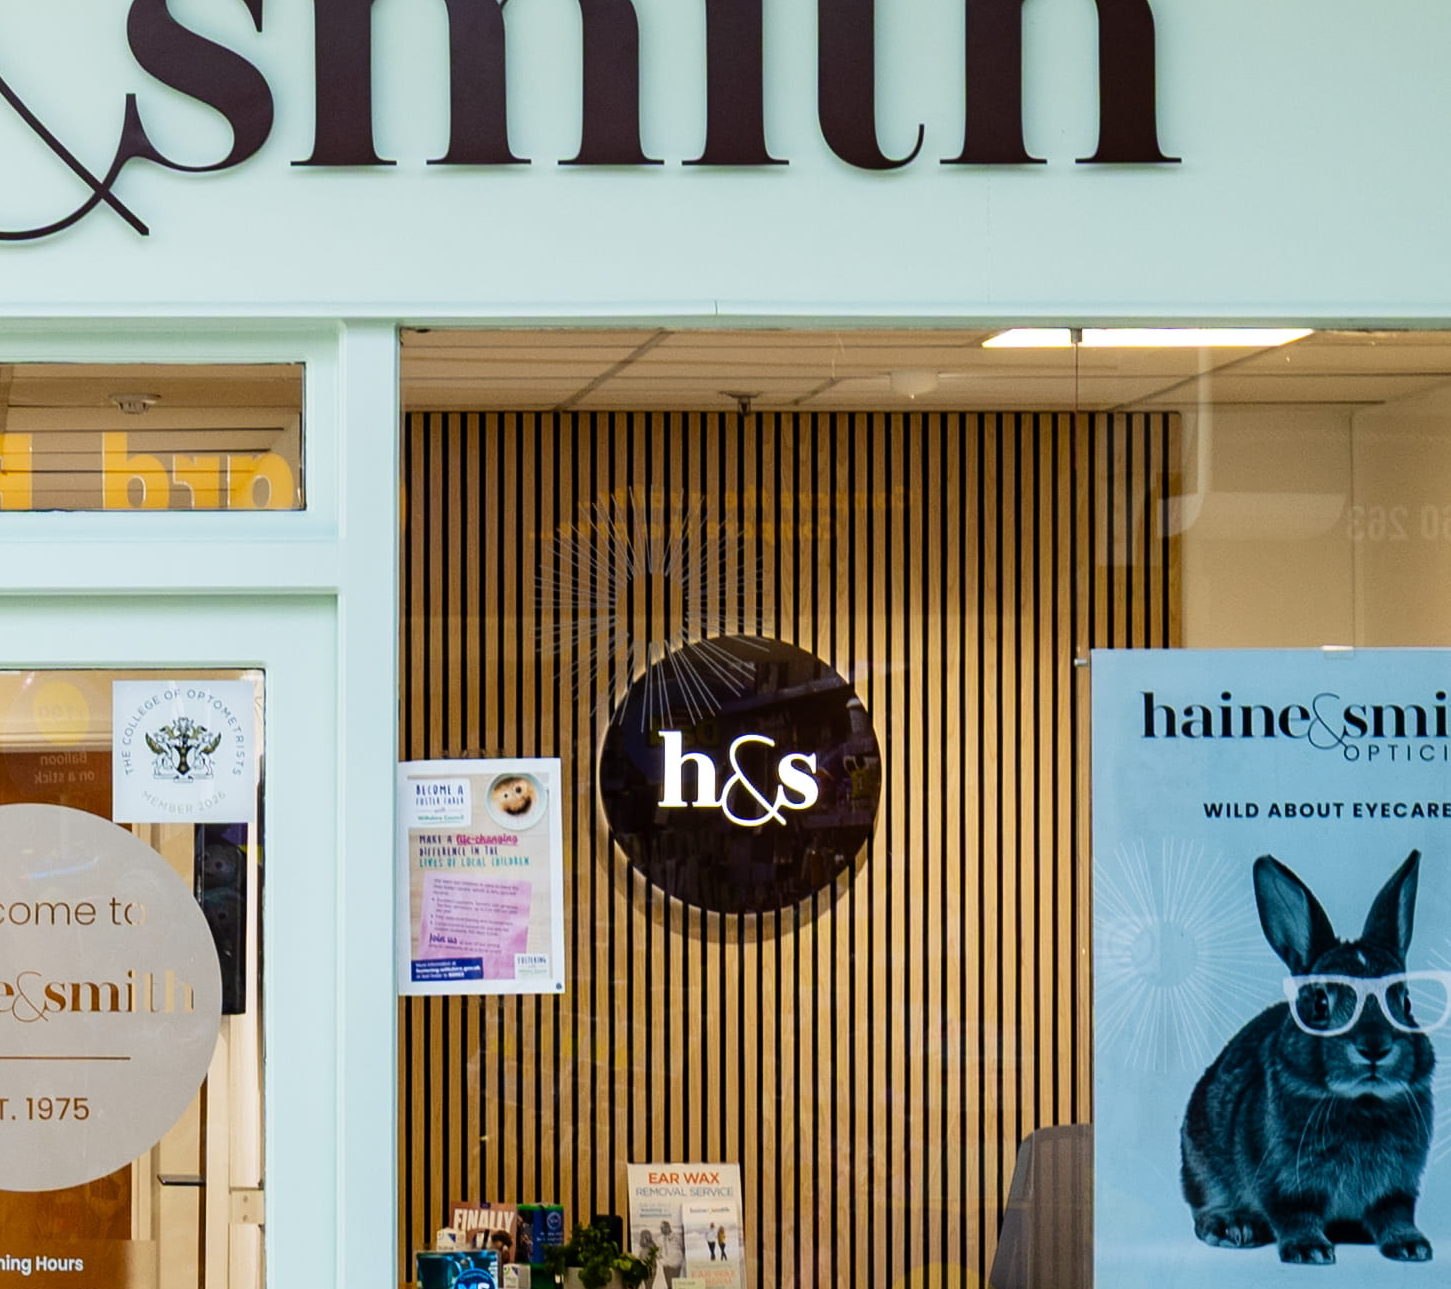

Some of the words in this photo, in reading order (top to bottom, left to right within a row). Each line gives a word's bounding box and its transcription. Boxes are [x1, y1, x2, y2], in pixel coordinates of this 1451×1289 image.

[122, 695, 161, 745] COLLEGE
[186, 688, 246, 776] OPTOMETRISTS
[657, 729, 821, 828] h&s
[416, 784, 451, 796] BECOME
[141, 790, 193, 815] MEMBER
[1203, 803, 1260, 819] WILD
[1267, 803, 1343, 819] ABOUT
[419, 834, 442, 844] MAKE
[419, 846, 467, 857] DIFFERENCE
[419, 858, 443, 868] LIVES
[461, 857, 487, 868] LOCAL
[491, 857, 530, 867] CHILDREN
[110, 896, 146, 926] to
[26, 1097, 90, 1121] 1975
[648, 1172, 679, 1184] EAR
[683, 1172, 720, 1184] WAX
[635, 1186, 686, 1197] REMOVAL
[690, 1186, 734, 1197] SERVICE
[453, 1208, 516, 1230] FINALLY
[35, 1255, 85, 1272] Hours
